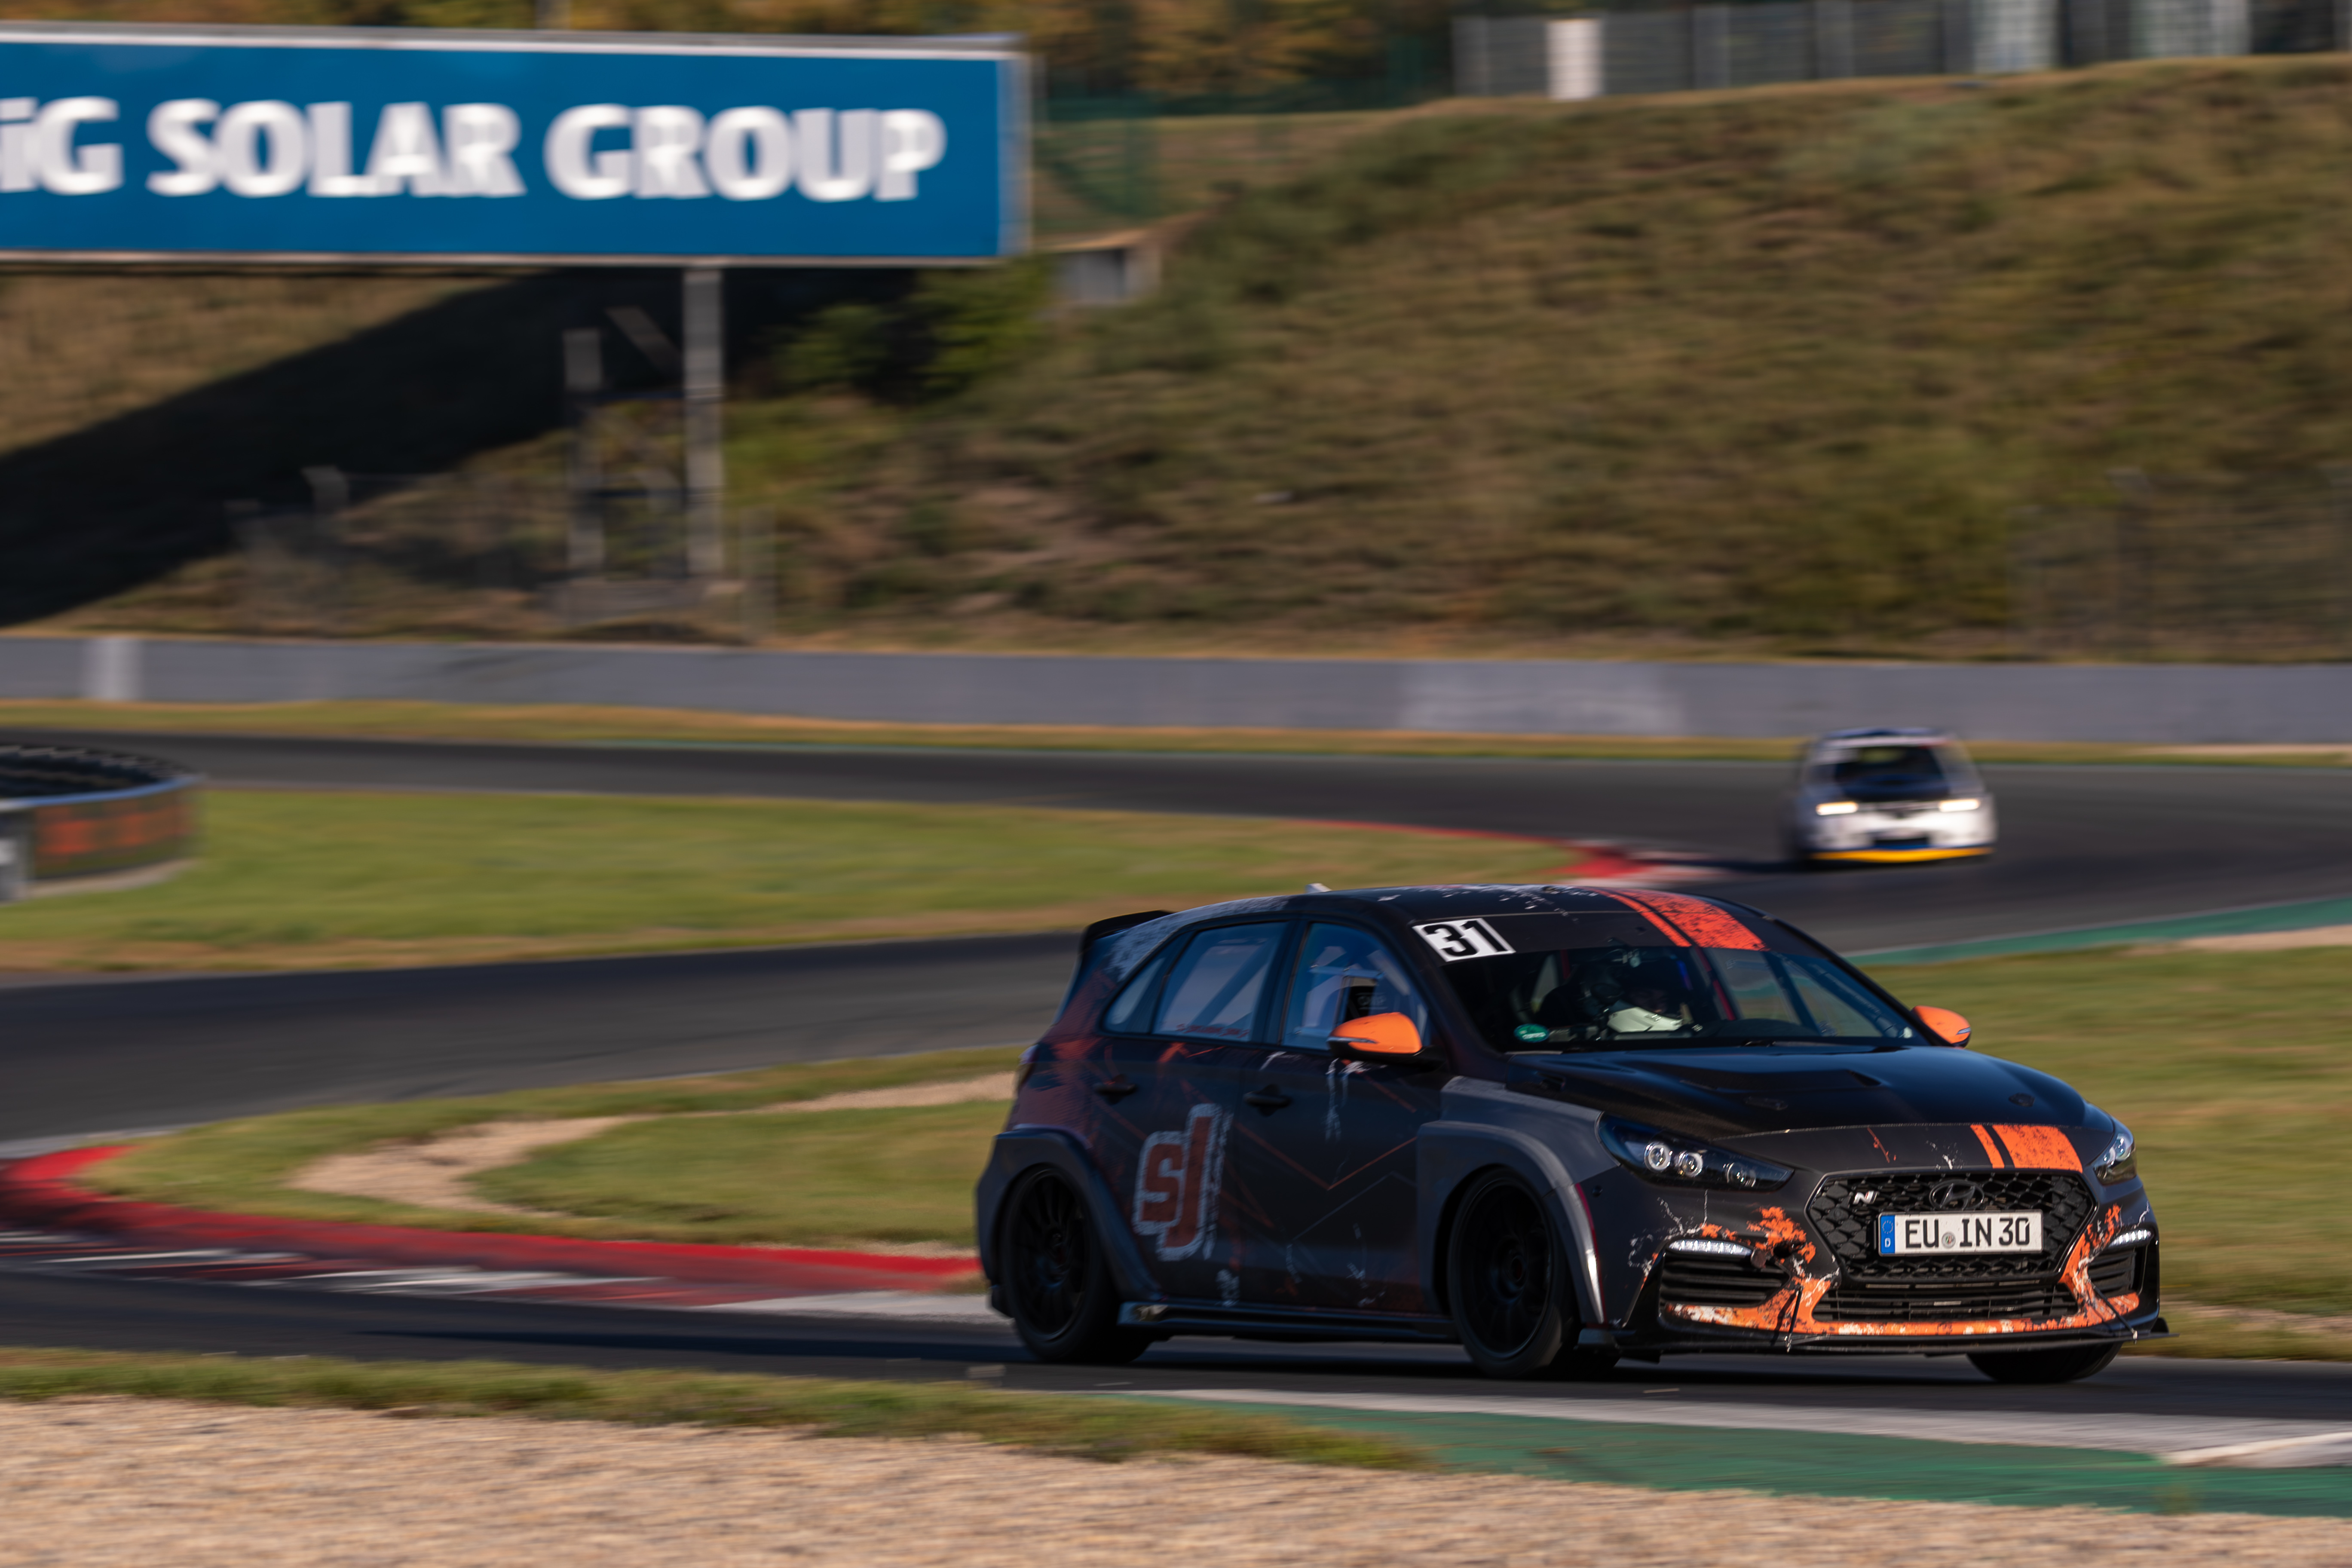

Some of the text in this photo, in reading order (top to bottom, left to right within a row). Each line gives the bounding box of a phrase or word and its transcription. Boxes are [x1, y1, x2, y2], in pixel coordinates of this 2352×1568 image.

[145, 98, 527, 198] SOLAR
[542, 103, 947, 202] GROUP
[1423, 920, 1507, 957] 31
[1884, 1237, 1891, 1248] D
[1905, 1217, 2030, 1248] EU IN 30
